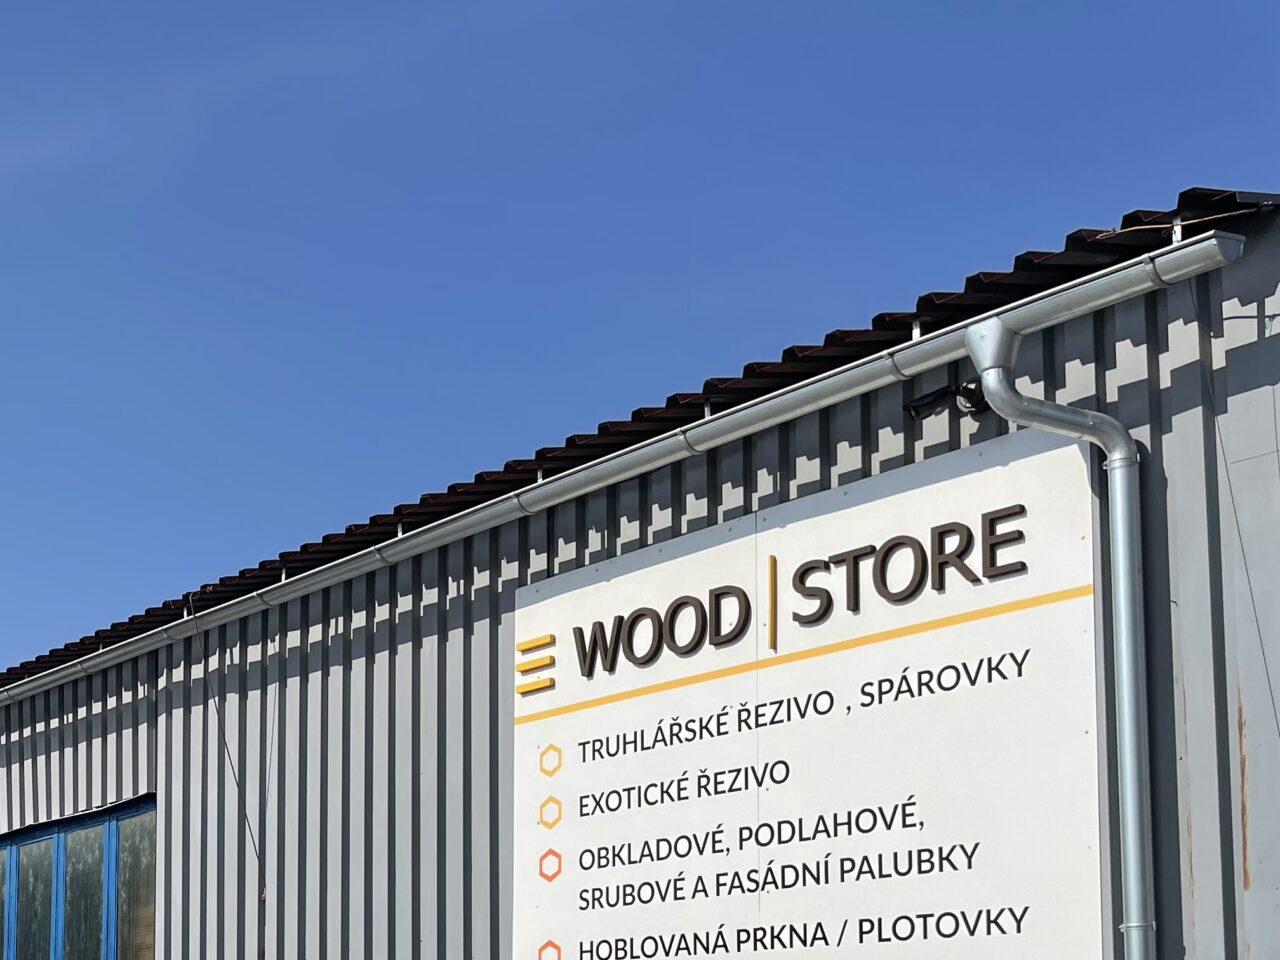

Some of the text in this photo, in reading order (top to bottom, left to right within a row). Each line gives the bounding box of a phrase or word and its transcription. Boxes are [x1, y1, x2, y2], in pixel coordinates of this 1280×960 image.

[572, 502, 1028, 679] WOOD STORE
[577, 705, 729, 763] TRUHLÁŘSKÉ
[737, 690, 835, 733] ŘEZIVO
[860, 648, 1031, 708] SPÁROVKY
[579, 760, 790, 818] EXOTICKÉ ŘEZIVO
[578, 794, 924, 871] OBKLADOVÉ, PODLAHOVÉ,
[578, 842, 980, 911] SRUBOVÉ A FASÁDNÍ PALUBKY
[736, 921, 830, 953] PRKNA
[858, 906, 1030, 944] PLOTOVKY
